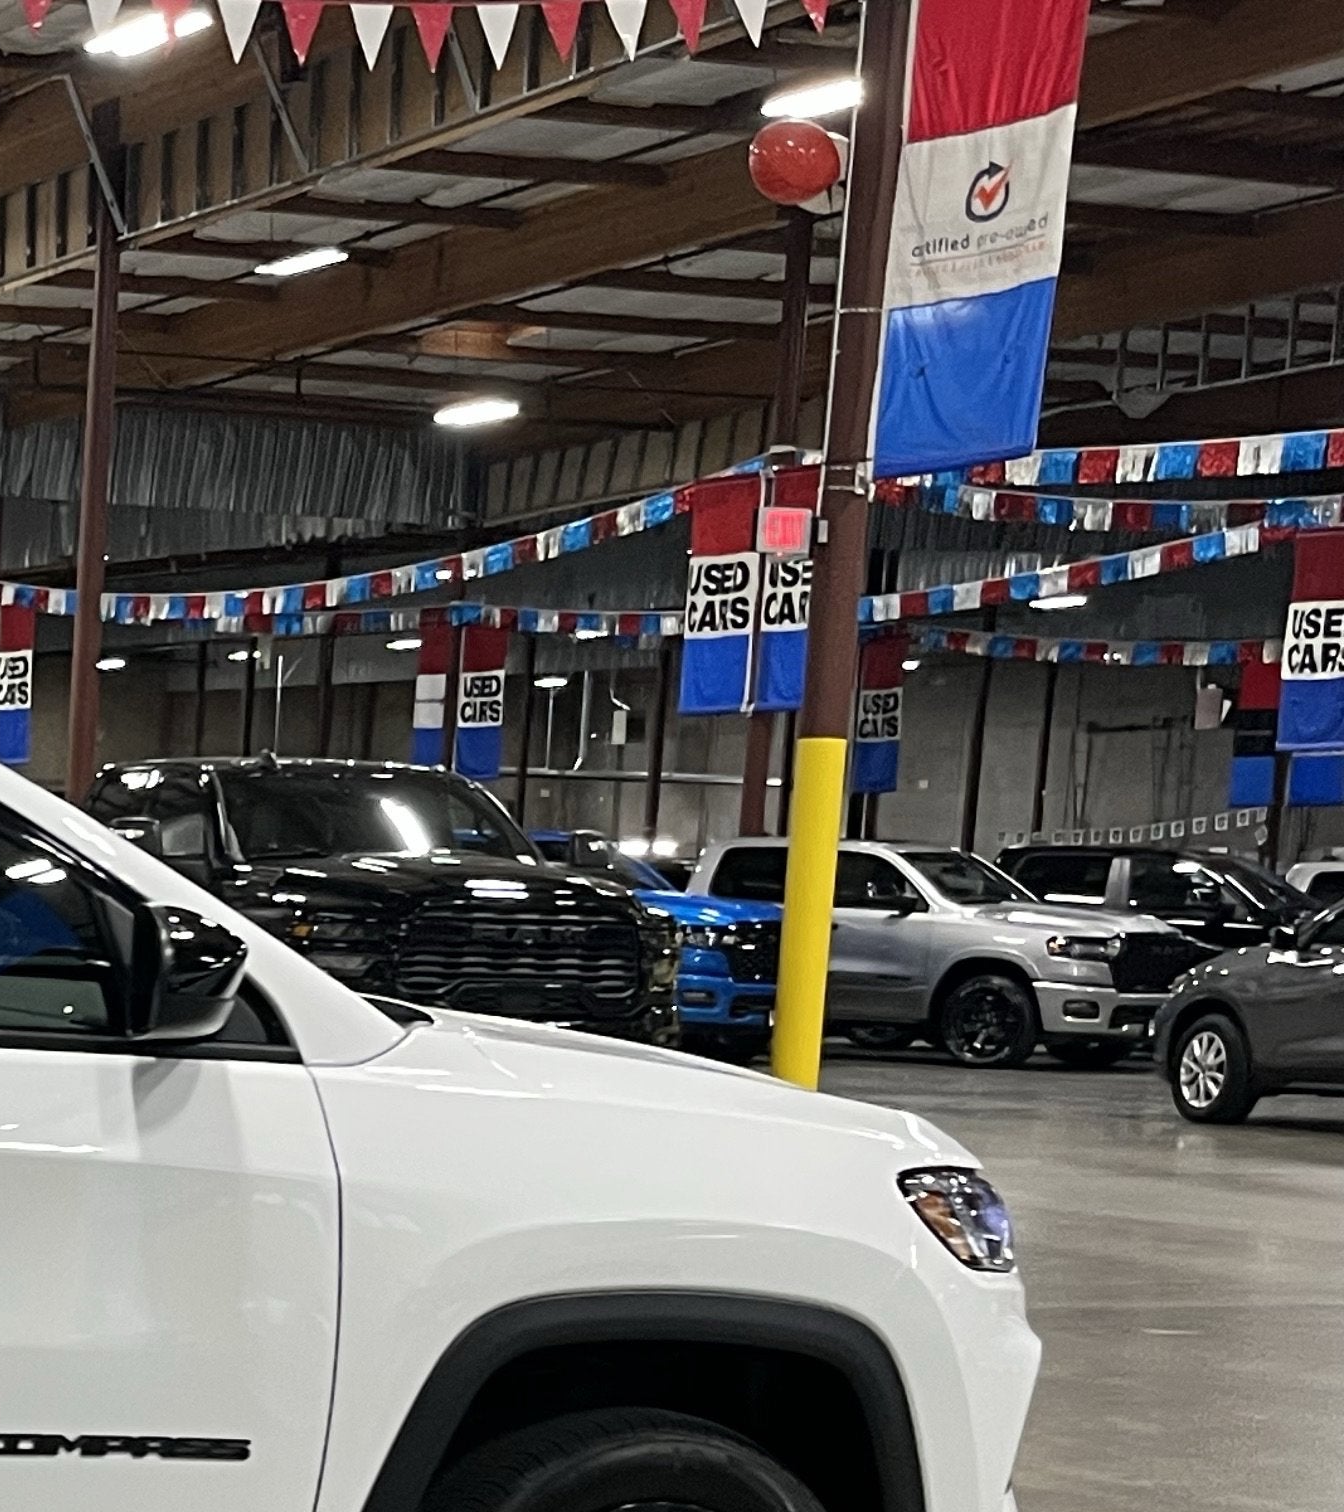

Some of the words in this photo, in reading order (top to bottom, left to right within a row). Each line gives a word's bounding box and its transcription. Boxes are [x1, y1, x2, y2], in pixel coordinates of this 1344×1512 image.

[690, 561, 751, 596] USED
[768, 561, 813, 588] USE
[687, 597, 751, 632] CARS
[764, 592, 810, 625] CAR
[1292, 608, 1344, 639] USE
[1288, 643, 1344, 674] CAR
[464, 675, 501, 698] USED
[460, 700, 502, 723] CARS
[862, 692, 899, 716] USED
